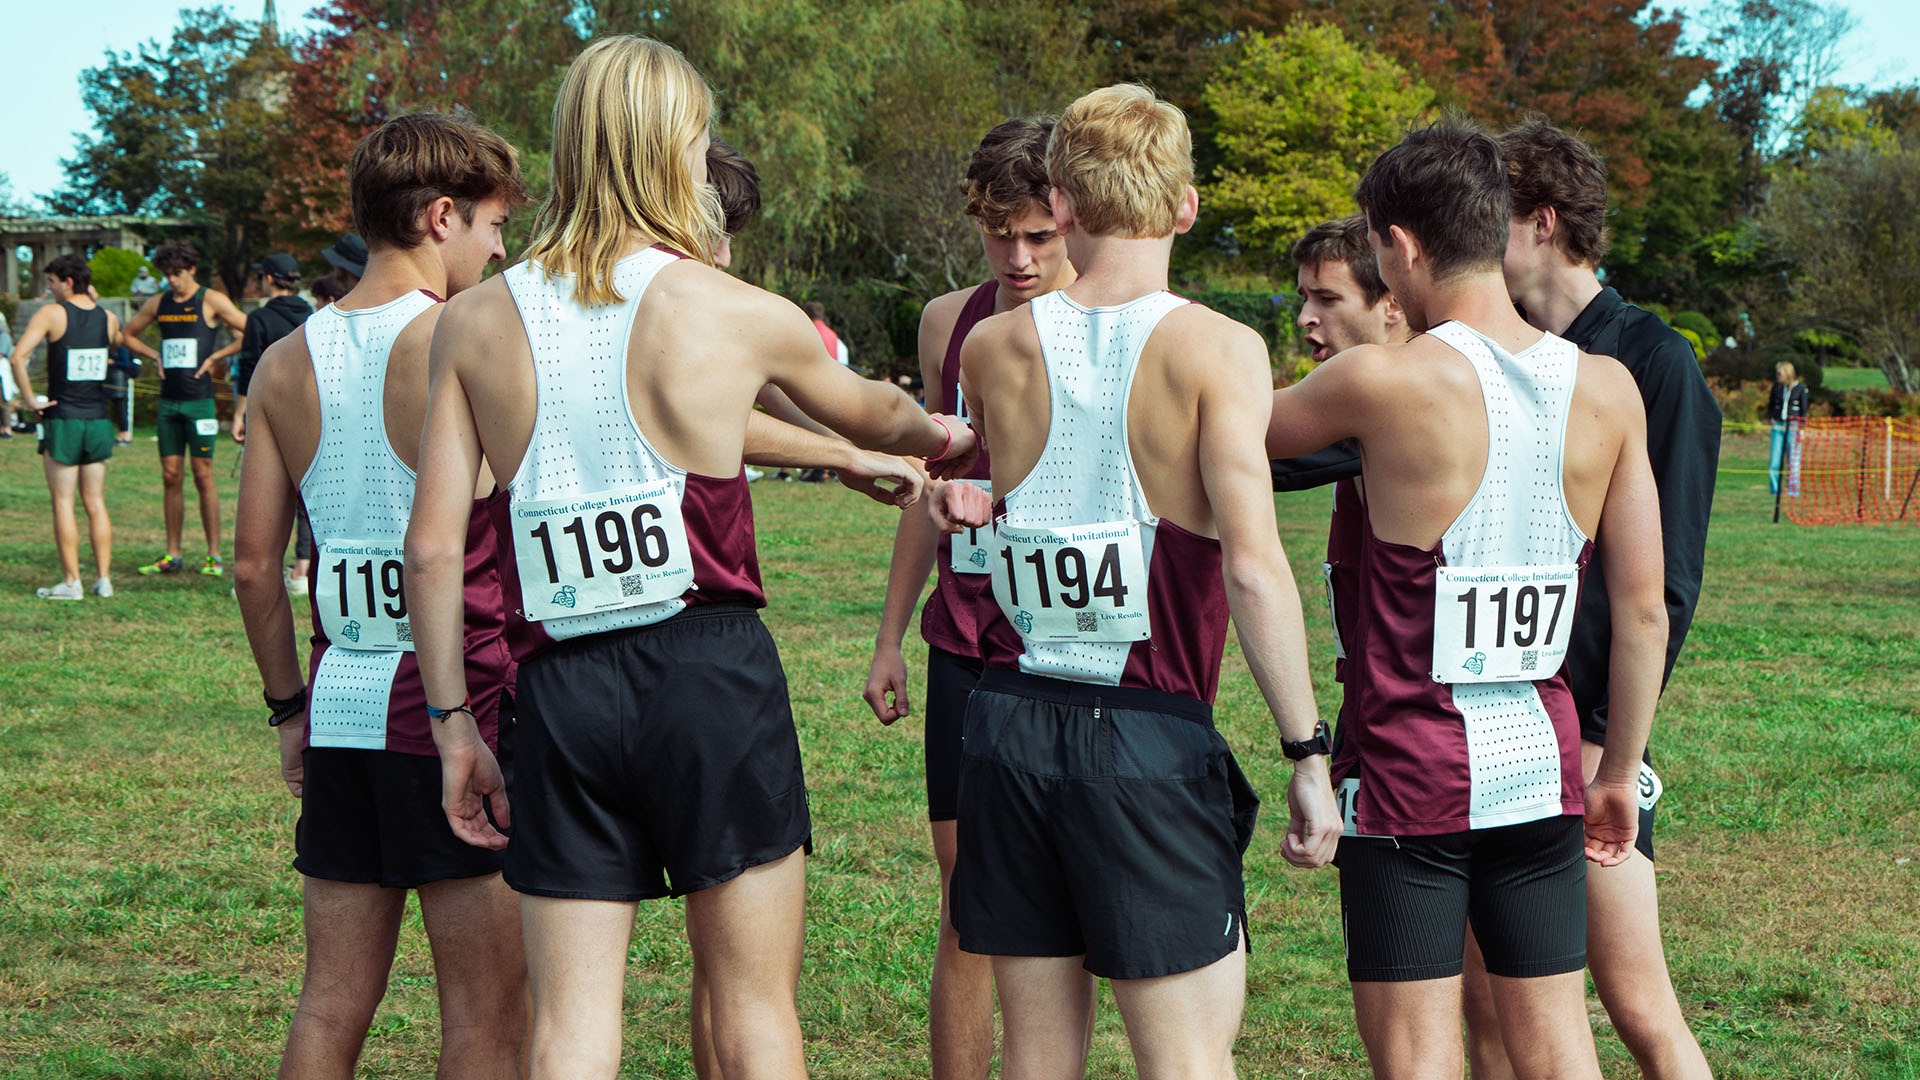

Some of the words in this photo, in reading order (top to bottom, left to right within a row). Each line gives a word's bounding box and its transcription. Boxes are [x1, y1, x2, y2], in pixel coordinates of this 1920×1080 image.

[166, 343, 187, 359] 204
[77, 355, 102, 373] 212
[517, 506, 568, 518] Connecticut
[571, 499, 607, 513] College
[609, 487, 666, 506] Invitational
[530, 503, 670, 584] 1196
[1033, 533, 1069, 546] College
[1071, 527, 1129, 543] Invitational
[325, 545, 364, 556] Connecticut
[365, 547, 392, 557] College
[645, 571, 662, 581] Live
[662, 567, 688, 578] Results
[1000, 542, 1128, 609] 1194
[1446, 573, 1499, 583] Connecticut
[1501, 572, 1531, 582] College
[1532, 570, 1574, 582] Invitational
[332, 558, 408, 619] 119
[1100, 613, 1117, 621] Live
[1117, 611, 1143, 621] Results
[1457, 584, 1567, 649] 1197
